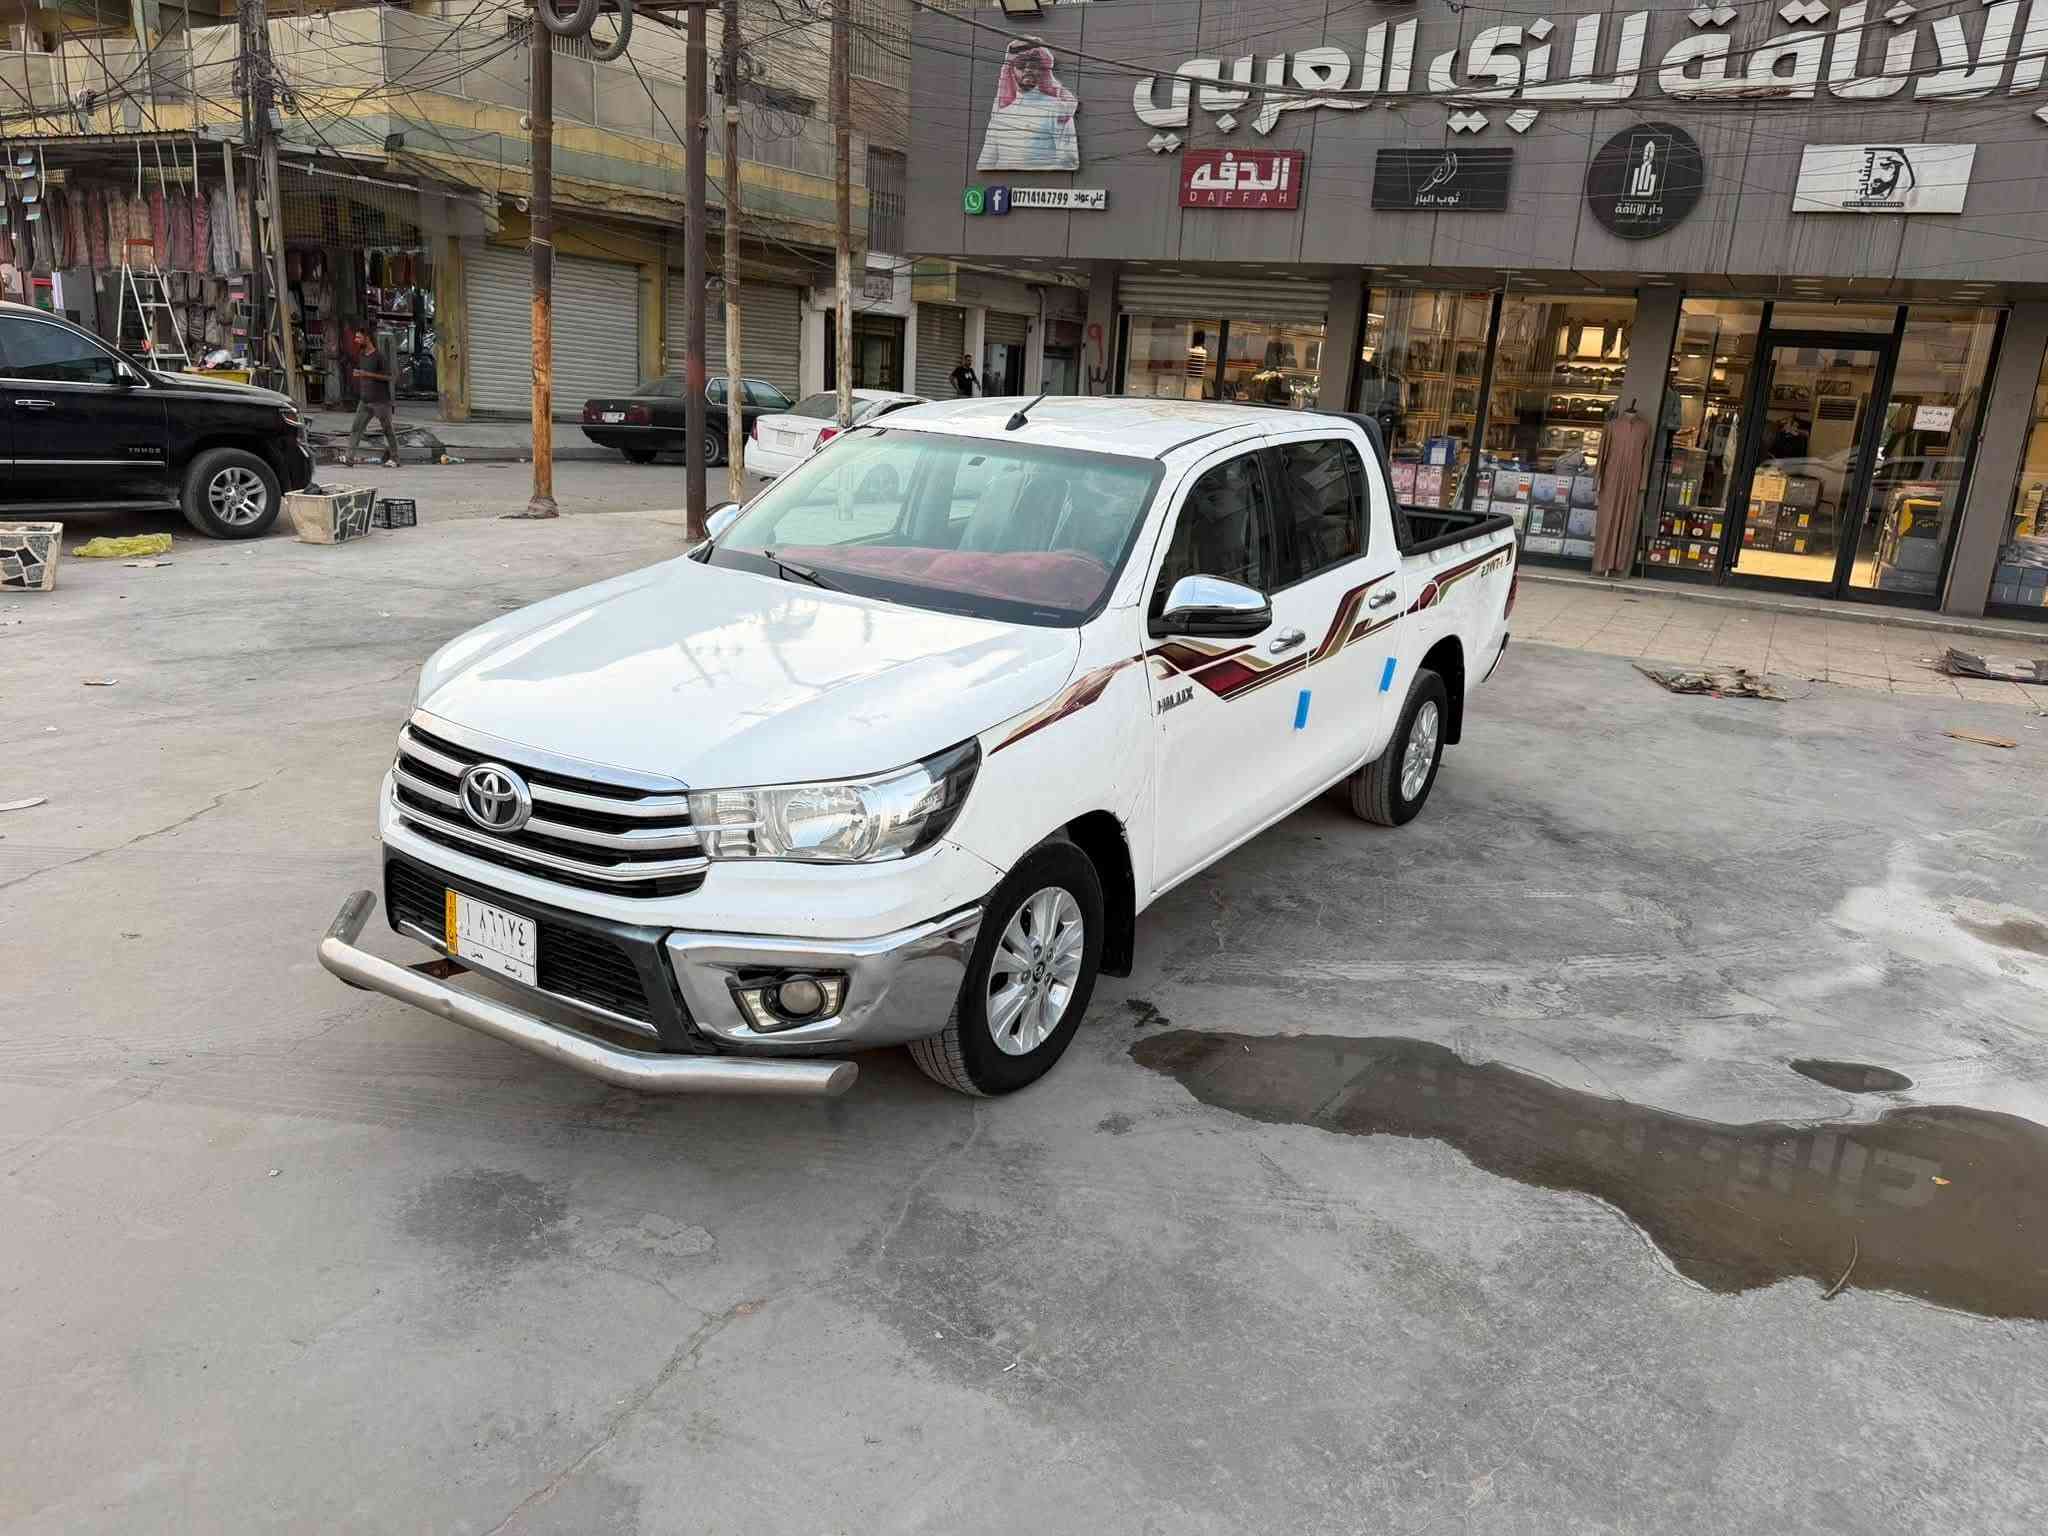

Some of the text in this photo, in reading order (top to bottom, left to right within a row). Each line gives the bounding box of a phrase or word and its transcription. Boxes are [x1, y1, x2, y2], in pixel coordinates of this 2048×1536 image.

[1133, 17, 1416, 153] العربي
[1012, 190, 1069, 206] 07714147799
[1189, 191, 1288, 203] DAFFAH
[1157, 686, 1194, 715] HILUX
